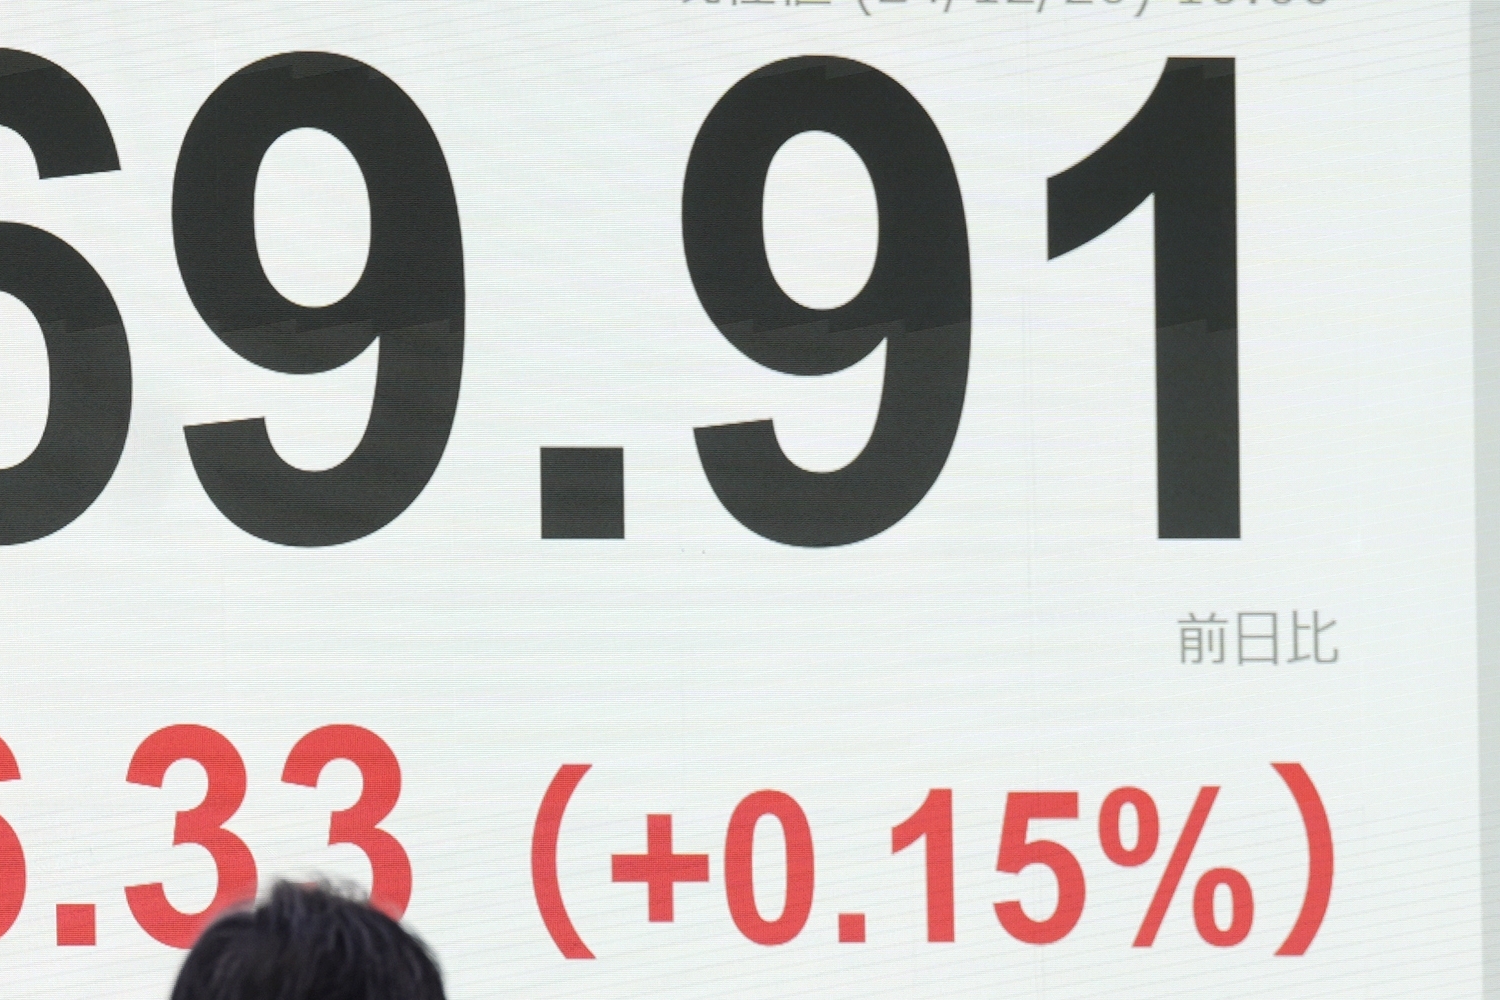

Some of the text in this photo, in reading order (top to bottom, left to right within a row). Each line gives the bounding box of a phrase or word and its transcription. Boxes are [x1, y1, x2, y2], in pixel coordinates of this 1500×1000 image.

[1178, 610, 1339, 665] 前日比
[532, 763, 1334, 960] (+0.15%)
